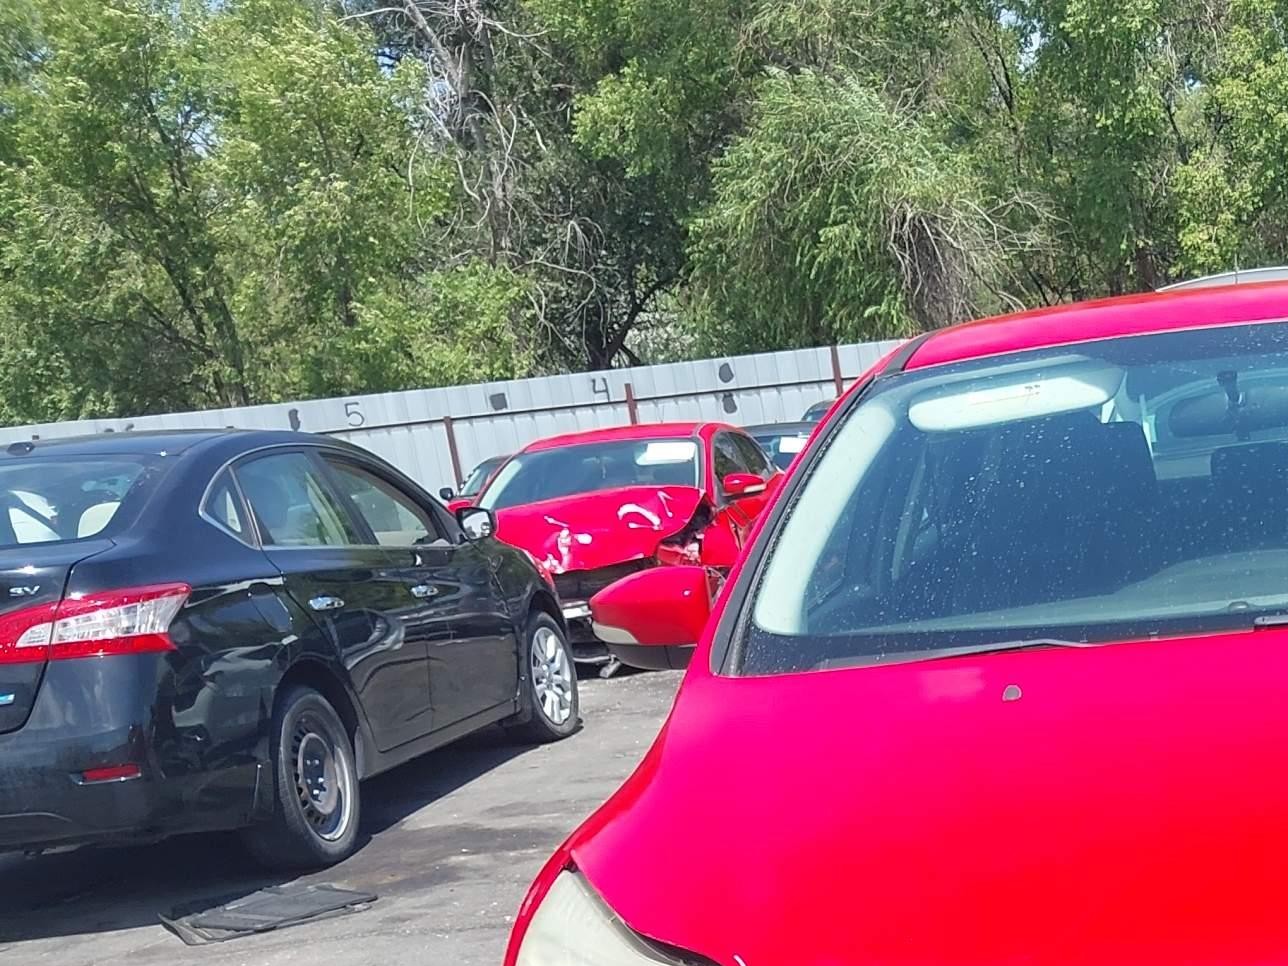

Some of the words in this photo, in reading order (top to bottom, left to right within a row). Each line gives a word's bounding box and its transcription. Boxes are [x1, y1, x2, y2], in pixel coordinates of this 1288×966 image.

[591, 377, 611, 402] 4
[344, 401, 365, 427] 5
[9, 585, 40, 597] SV
